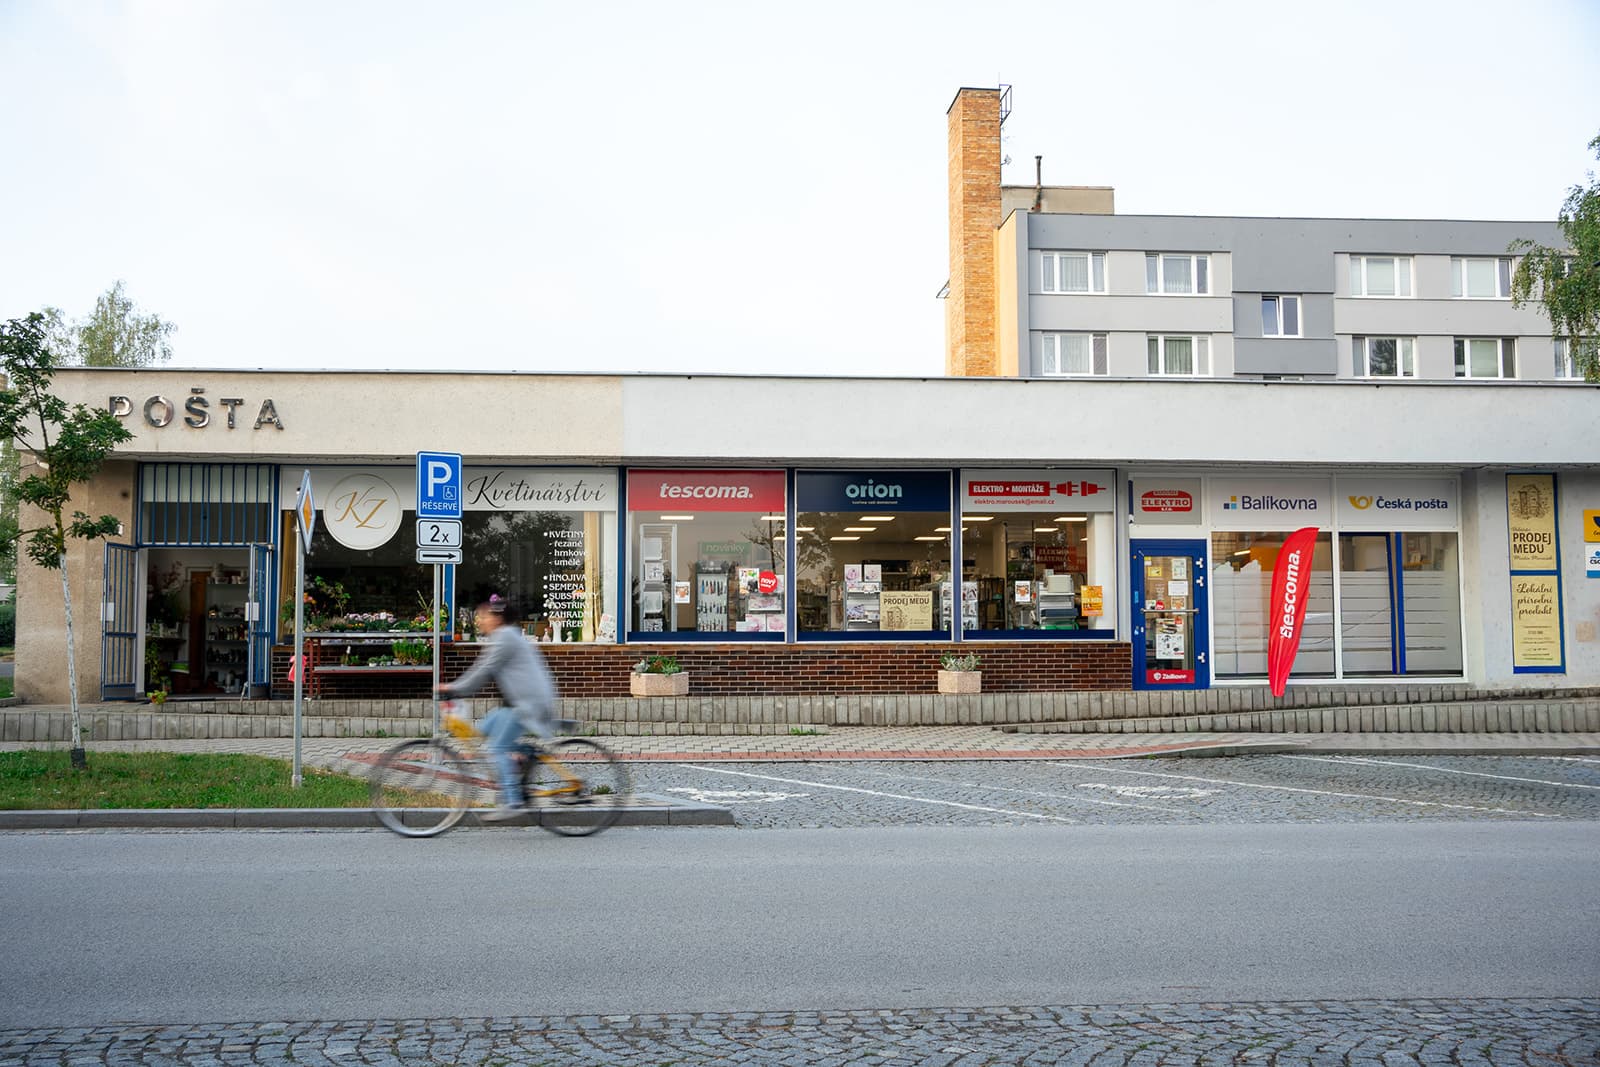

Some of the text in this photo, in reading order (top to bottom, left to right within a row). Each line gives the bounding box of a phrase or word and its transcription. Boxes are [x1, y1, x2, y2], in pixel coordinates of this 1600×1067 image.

[109, 388, 284, 430] POŠTA
[427, 461, 452, 497] P
[467, 471, 606, 509] Květinářství
[845, 479, 903, 498] orion
[973, 483, 1044, 493] ELEKTRO MONTÁŽE
[1142, 498, 1190, 506] ELEKTRO
[1376, 495, 1448, 511] Česká pošta
[549, 530, 586, 538] KVĚTINY
[1512, 532, 1552, 545] PRODEJ
[1513, 543, 1545, 554] MEDU
[549, 573, 587, 581] HNOJIVA
[549, 583, 584, 591] SEMENA
[883, 597, 930, 606] PRODEJ MEDU
